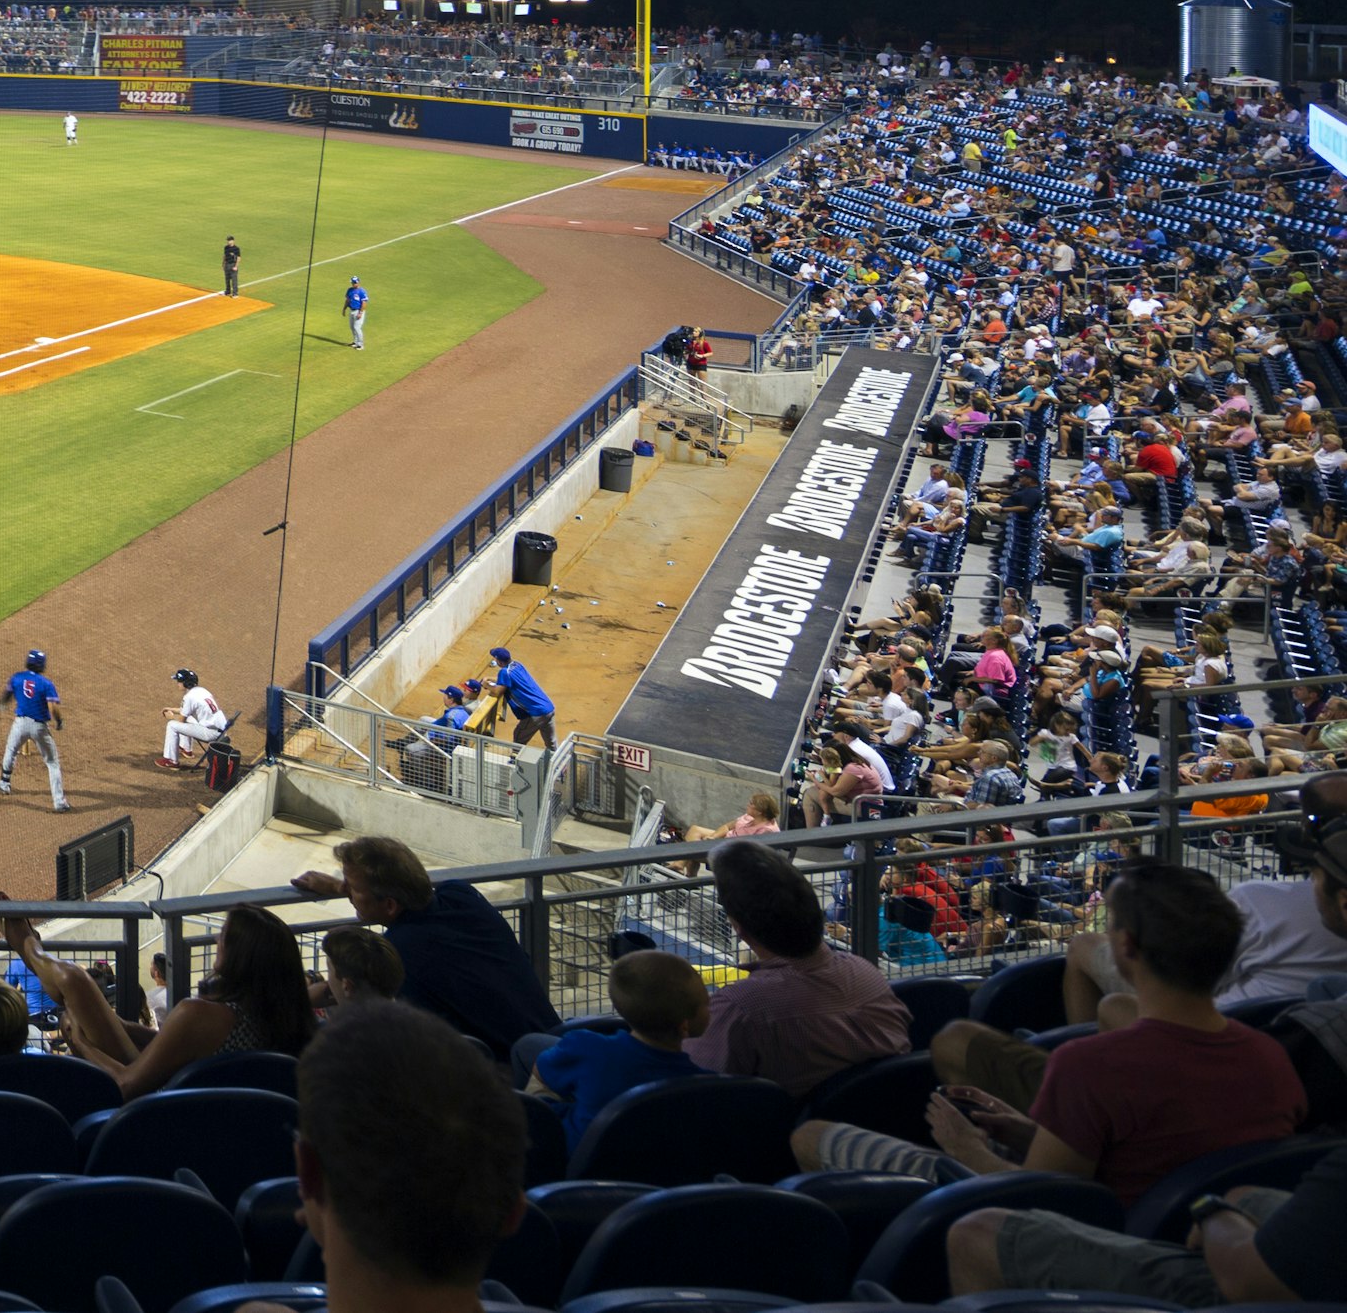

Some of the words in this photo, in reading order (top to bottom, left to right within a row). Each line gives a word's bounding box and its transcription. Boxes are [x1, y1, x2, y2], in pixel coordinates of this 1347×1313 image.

[103, 39, 144, 48] CHARLES
[146, 39, 183, 49] PITMAN
[108, 50, 150, 58] ATTORNEYS
[102, 60, 135, 71] FAN
[138, 60, 183, 72] ZONE
[127, 91, 177, 103] 422-2222
[541, 126, 552, 135] 615
[598, 117, 620, 131] 310
[512, 137, 530, 147] BOOK
[530, 139, 535, 148] A
[535, 140, 558, 150] GROUP
[558, 142, 582, 153] TODAY!
[821, 366, 914, 437] BRIDGESTONE
[765, 439, 879, 541] BRIDGESTONE
[680, 544, 832, 700] BRIDGESTONE
[23, 679, 36, 699] 5
[618, 745, 645, 764] EXIT
